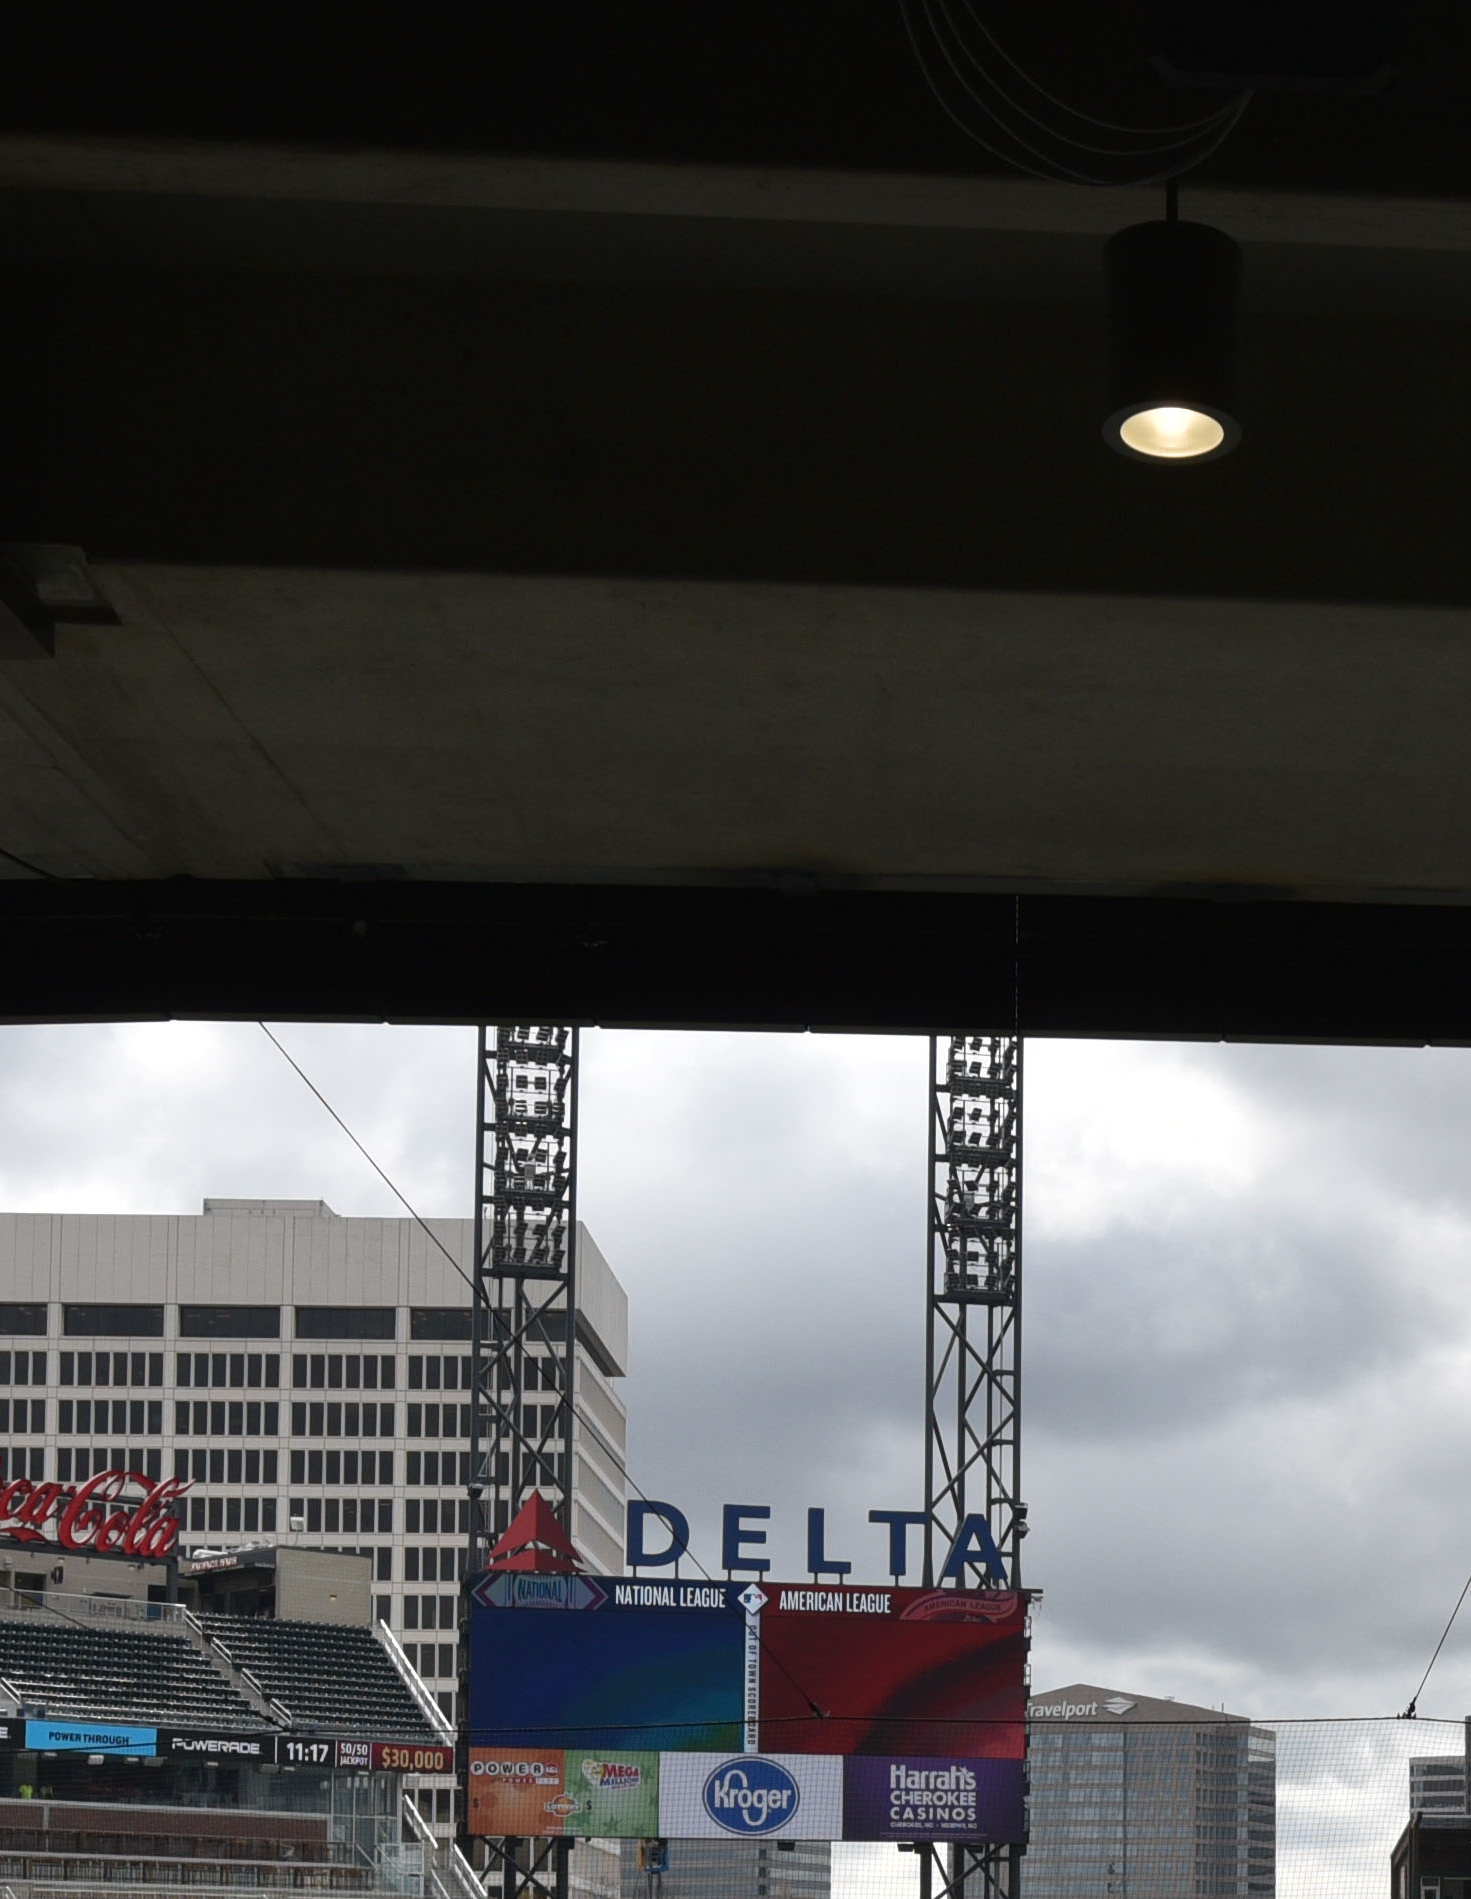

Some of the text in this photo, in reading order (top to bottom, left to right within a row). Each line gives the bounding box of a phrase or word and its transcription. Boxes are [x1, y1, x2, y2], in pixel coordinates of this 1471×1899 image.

[627, 1500, 1009, 1582] DELTA
[615, 1584, 727, 1609] NATIONAL LEAGUE
[779, 1590, 892, 1614] AMERICAN LEAGUE
[748, 1645, 757, 1655] OF
[748, 1659, 757, 1684] TOWN
[48, 1731, 129, 1747] POWER THROUGH
[172, 1736, 261, 1755] POWERADE
[286, 1741, 329, 1763] 11:17
[340, 1742, 369, 1757] 50/50
[382, 1746, 445, 1770] $30,000
[340, 1756, 369, 1766] JACKPOT
[713, 1770, 792, 1825] Kroger
[890, 1790, 977, 1807] CHEROKEE
[890, 1806, 977, 1822] CASINOS
